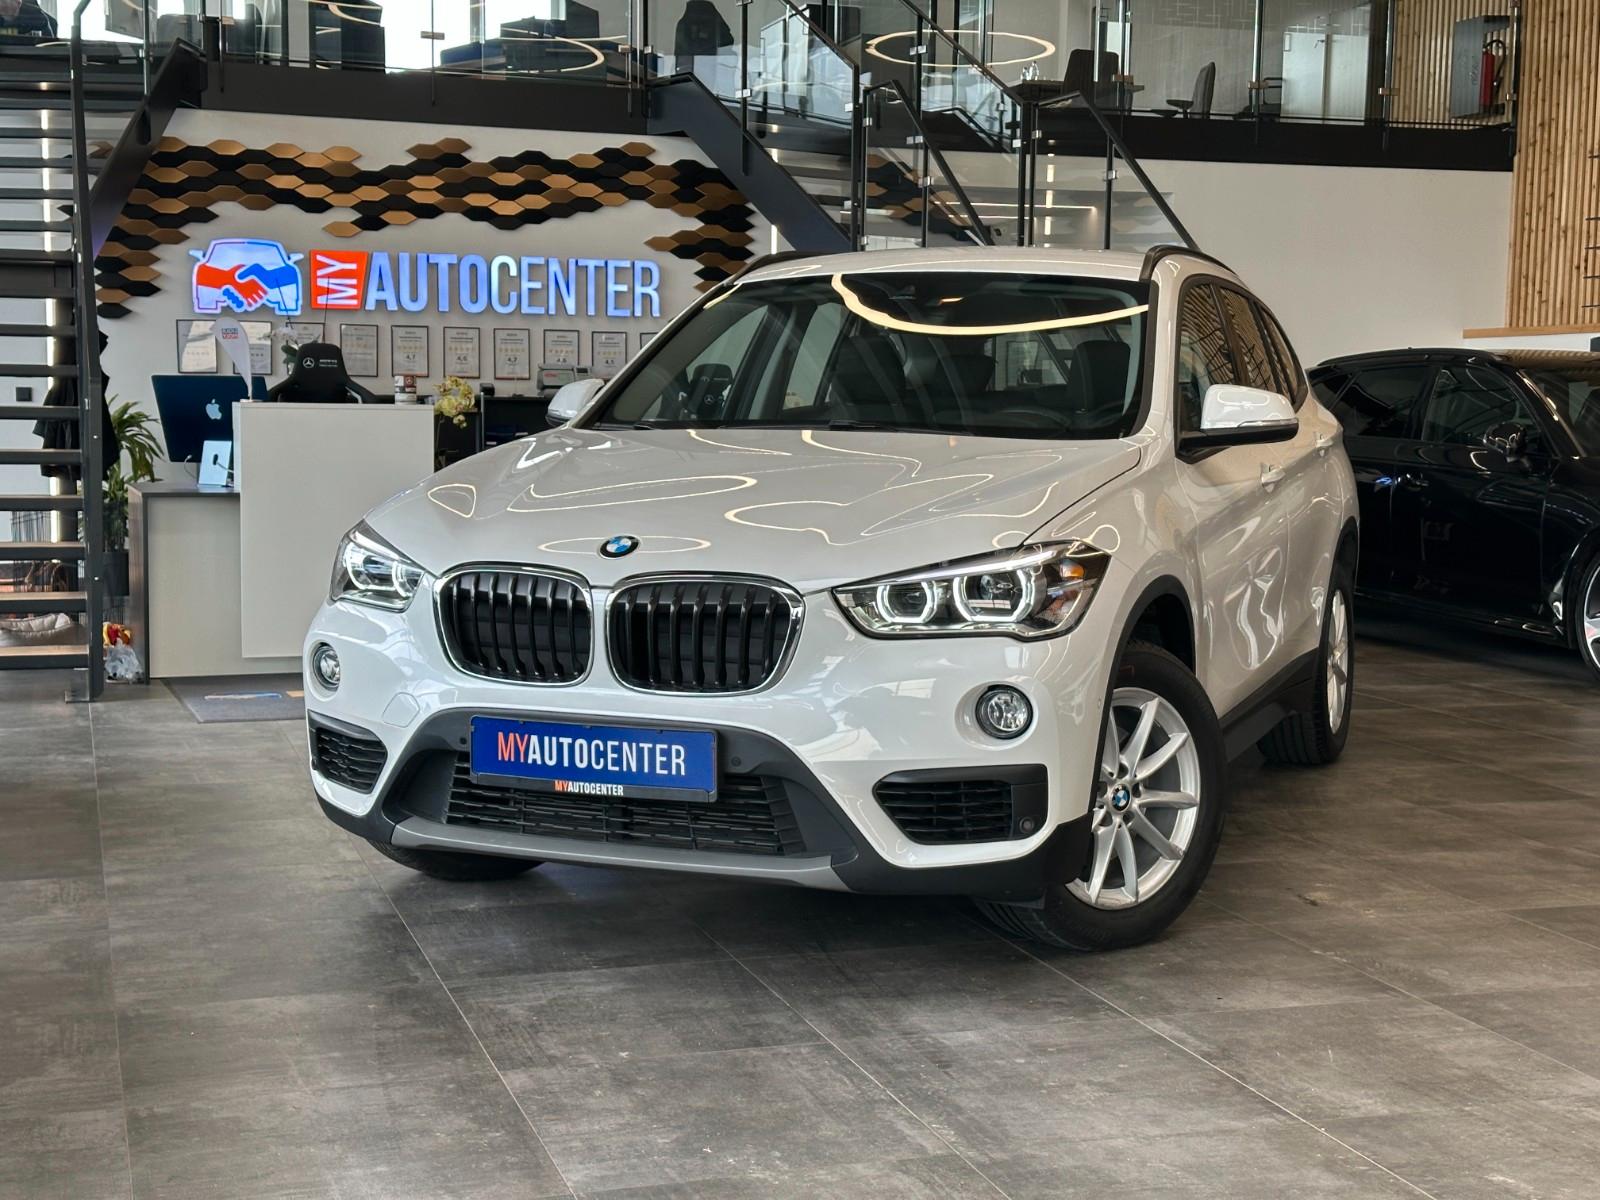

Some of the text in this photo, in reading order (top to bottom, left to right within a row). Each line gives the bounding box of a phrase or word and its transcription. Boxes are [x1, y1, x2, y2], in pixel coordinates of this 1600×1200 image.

[316, 251, 660, 317] MY AUTOCENTER
[497, 731, 686, 776] MYAUTOCENTER
[554, 780, 624, 796] MYAUTOCENTER
